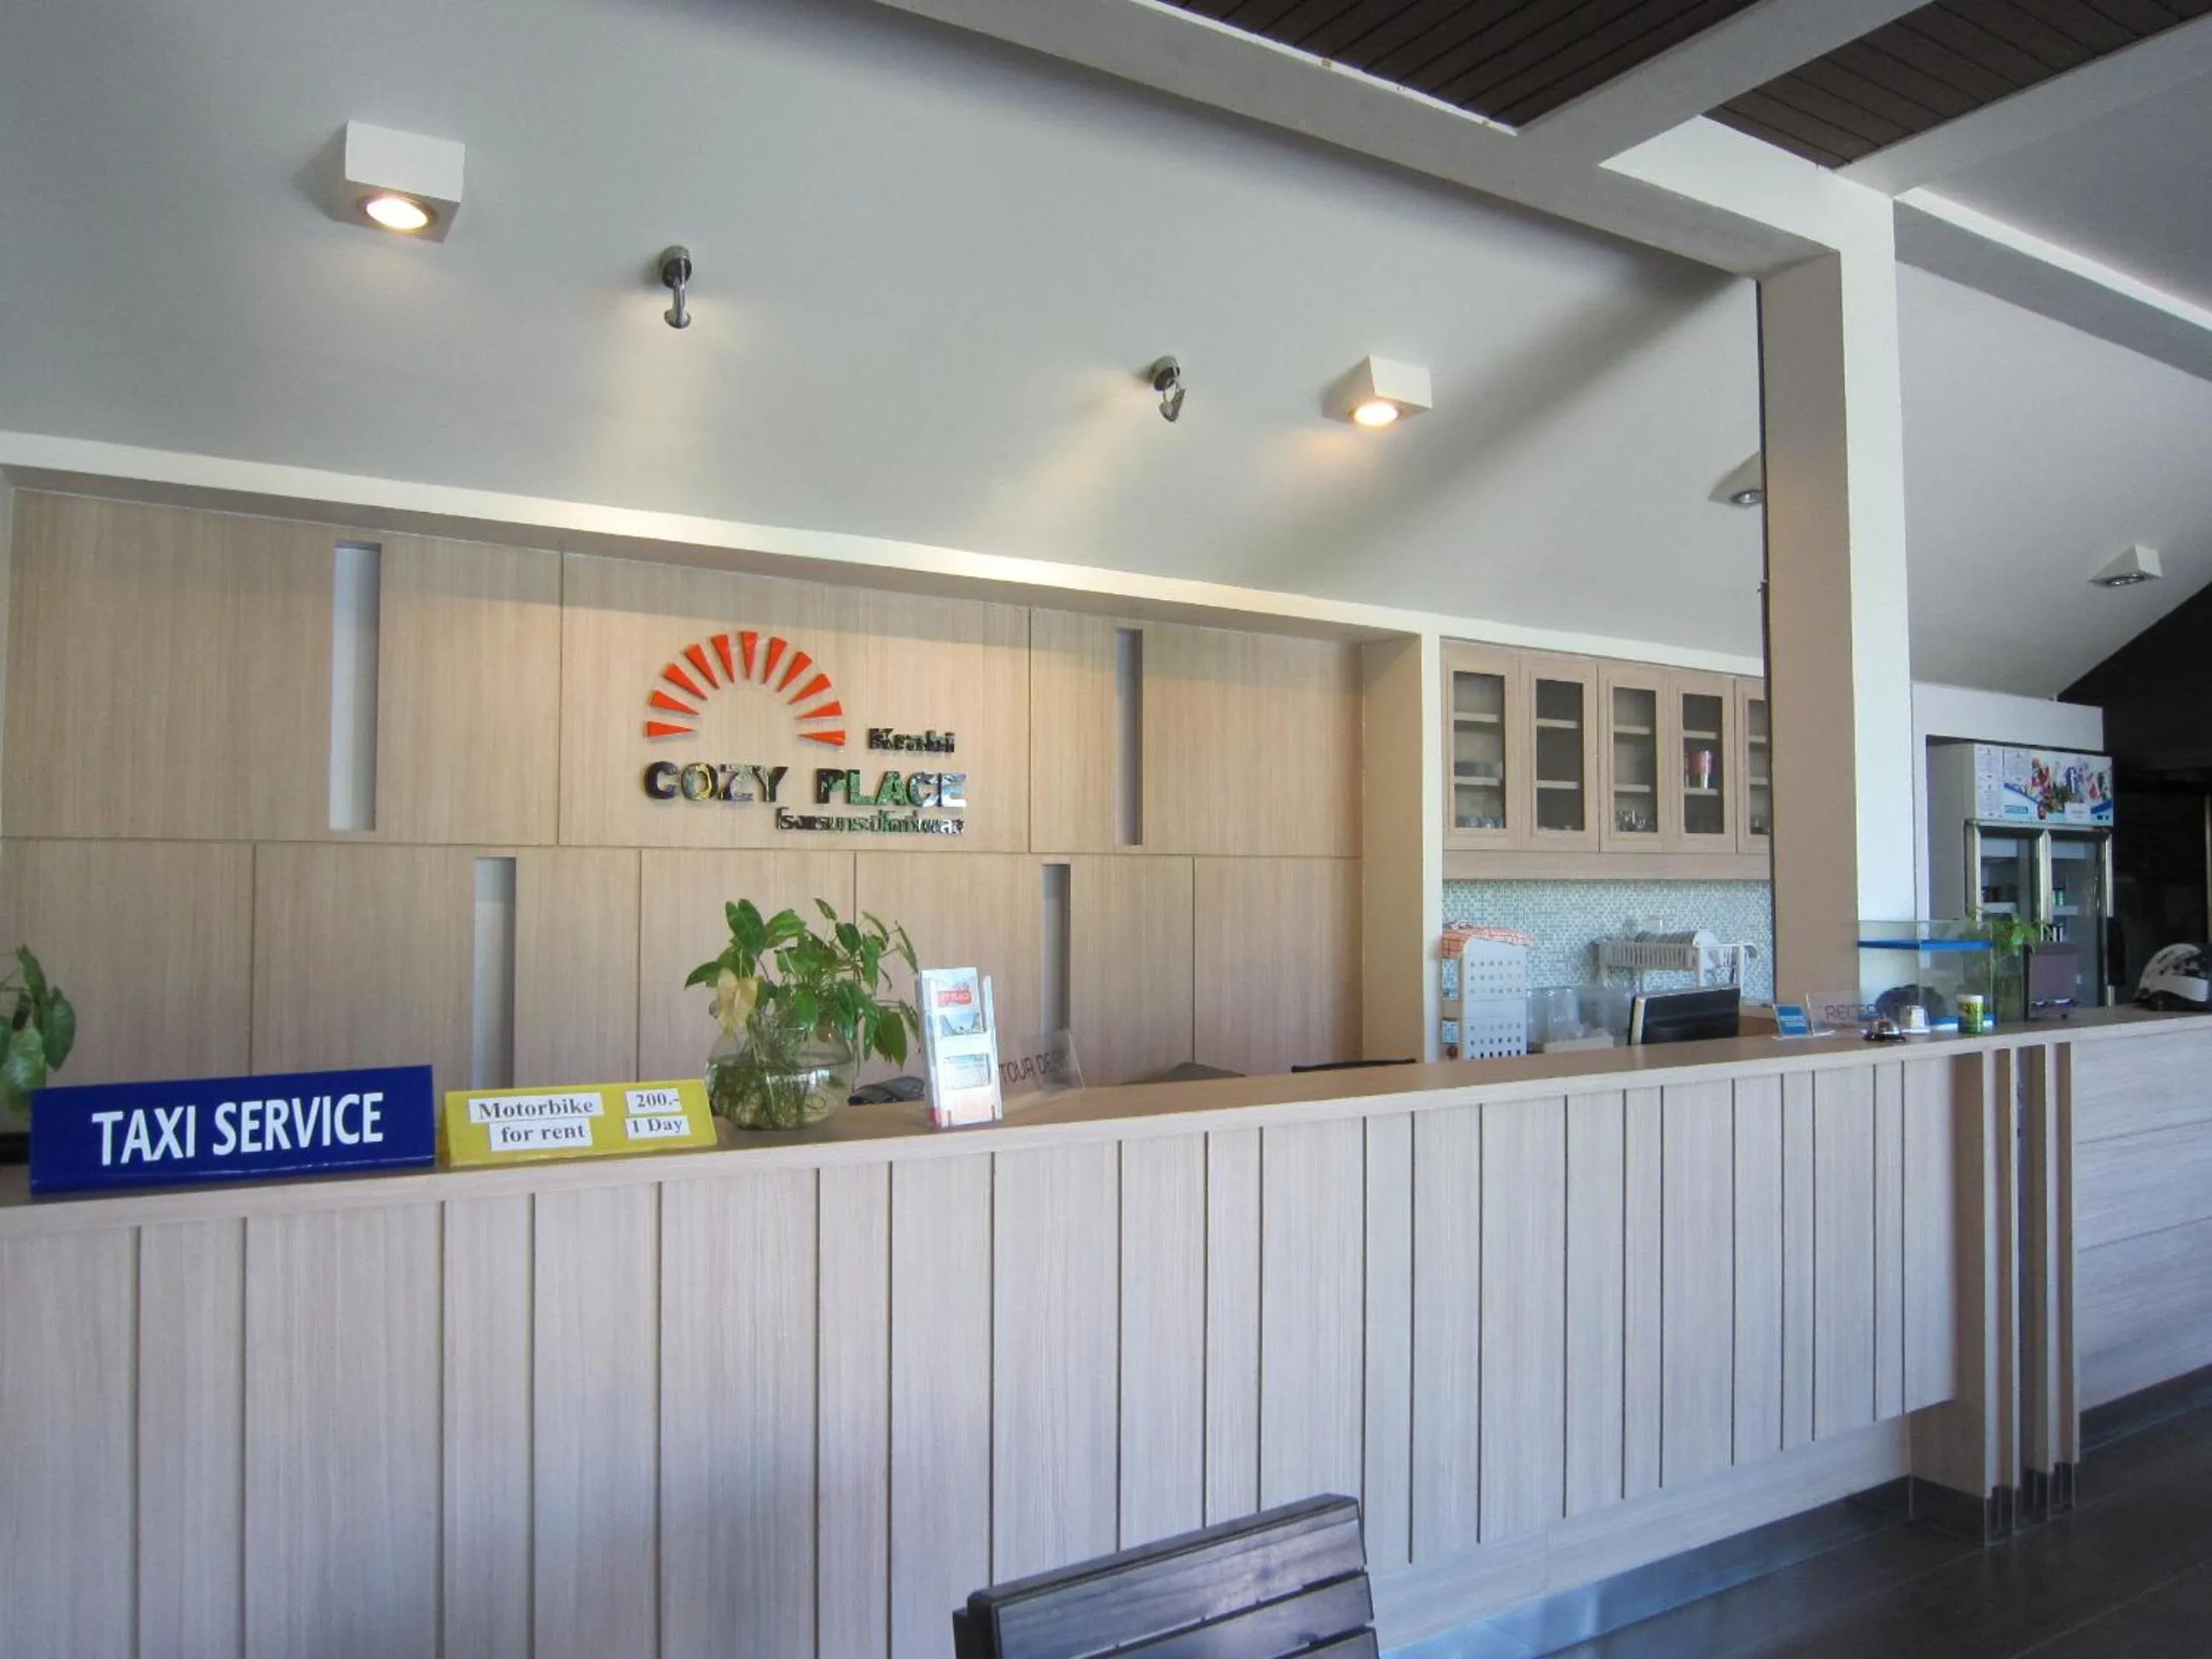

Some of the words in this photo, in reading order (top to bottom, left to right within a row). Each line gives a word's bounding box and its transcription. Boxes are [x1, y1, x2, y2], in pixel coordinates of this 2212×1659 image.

[644, 761, 789, 802] COZY
[816, 769, 967, 807] PLACE
[479, 1097, 594, 1120] Motorbike
[92, 1105, 195, 1166] TAXI
[212, 1092, 383, 1155] SERVICE
[500, 1126, 533, 1144] for
[541, 1124, 586, 1140] rent
[632, 1120, 639, 1133] 1
[648, 1117, 683, 1134] Day
